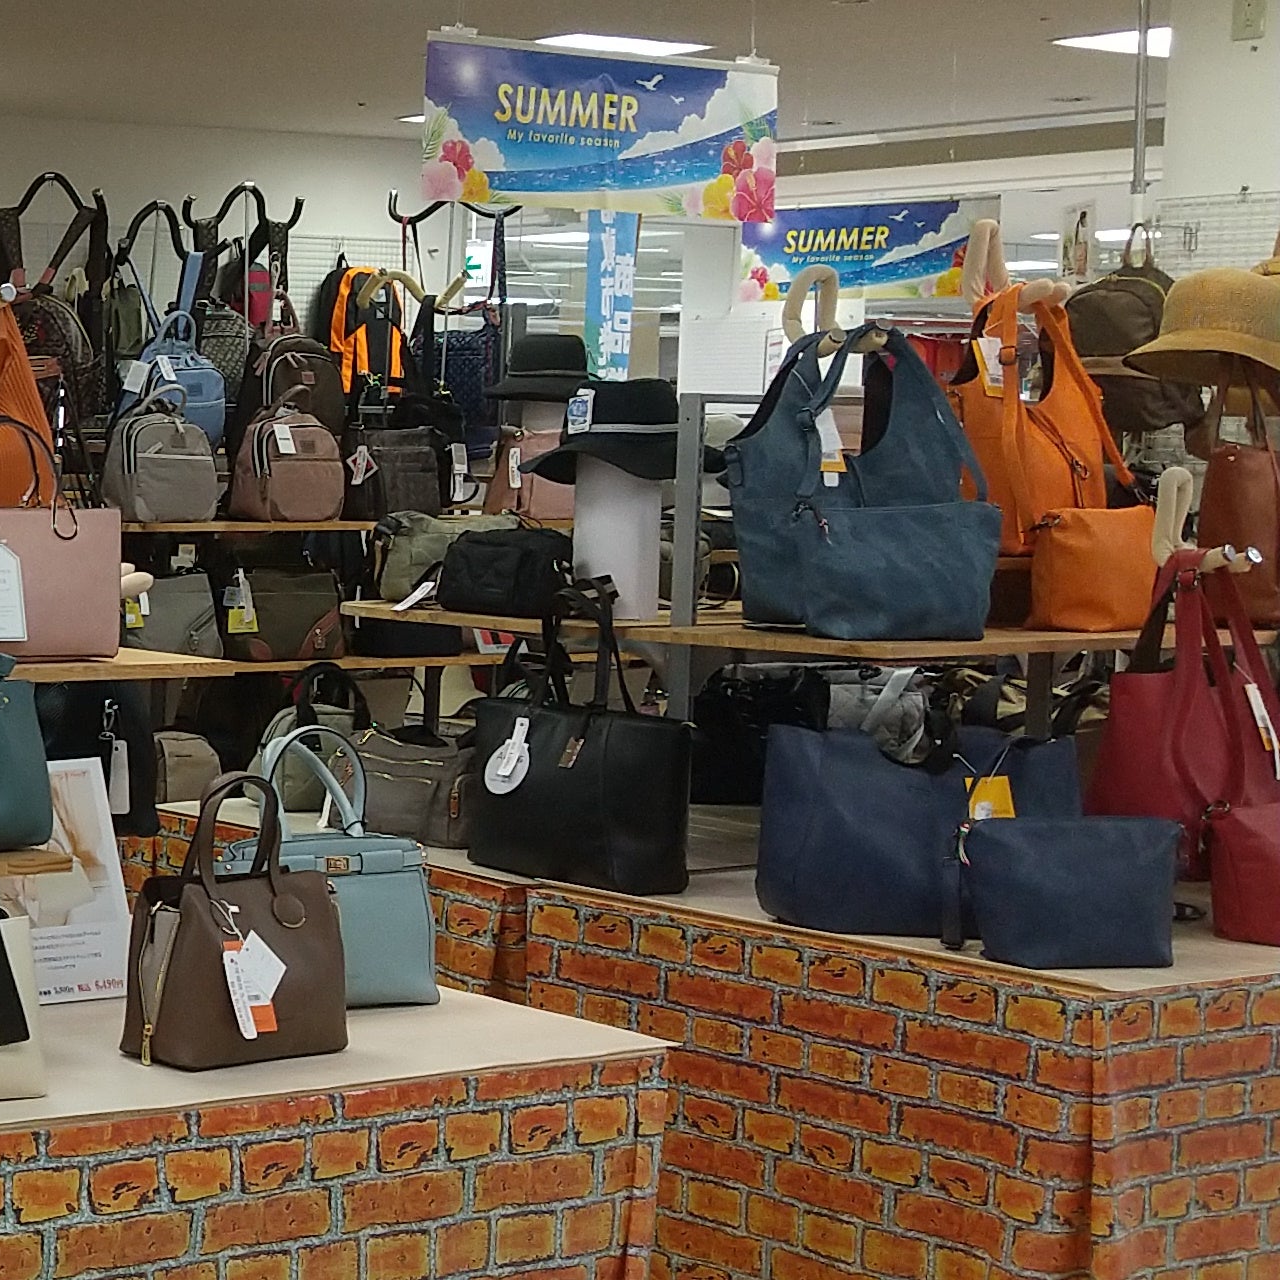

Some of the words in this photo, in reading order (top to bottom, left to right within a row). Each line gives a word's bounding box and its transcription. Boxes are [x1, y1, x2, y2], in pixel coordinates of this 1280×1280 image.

[494, 83, 639, 133] SUMMER
[506, 129, 524, 143] My
[528, 130, 576, 145] favorite
[579, 135, 621, 149] season
[782, 225, 890, 254] SUMMER
